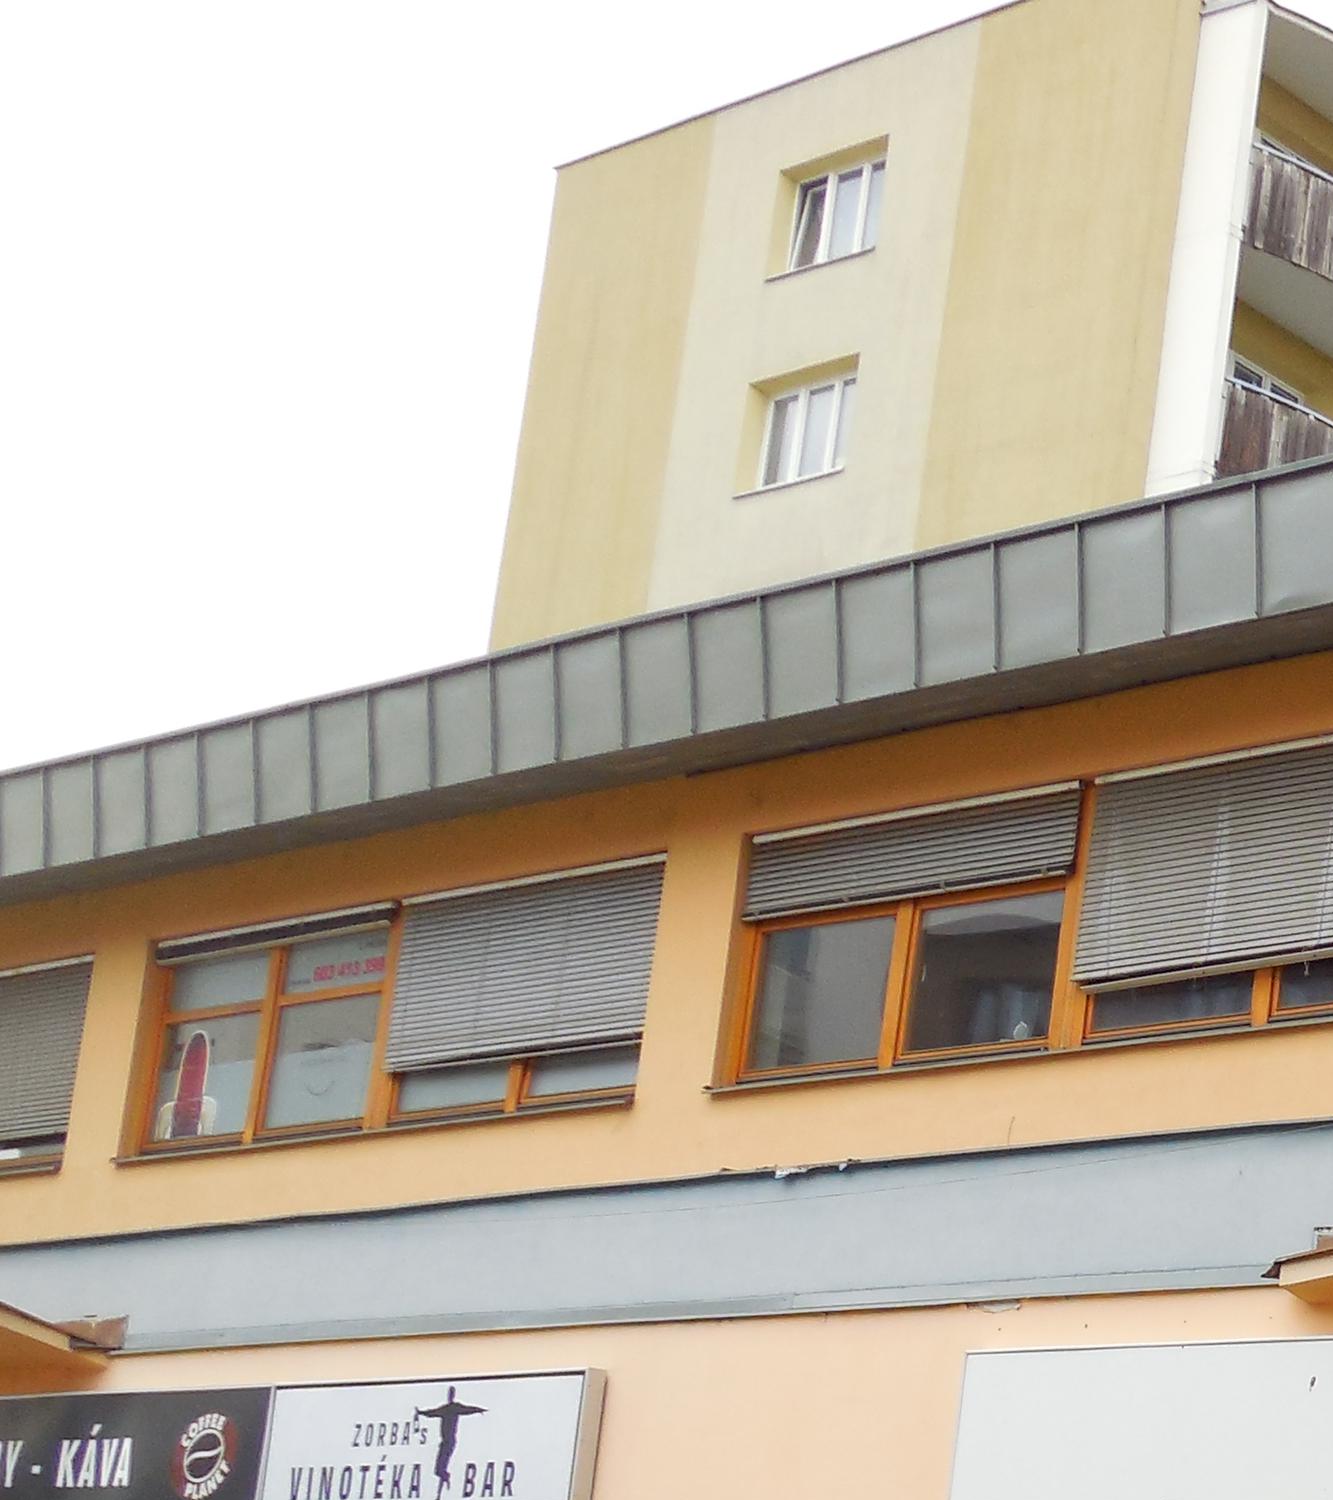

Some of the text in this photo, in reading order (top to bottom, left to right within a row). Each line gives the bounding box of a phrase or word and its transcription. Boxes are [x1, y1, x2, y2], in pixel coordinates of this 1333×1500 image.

[180, 1413, 227, 1448] COFFEE
[55, 1423, 133, 1488] KÁVA
[290, 1455, 515, 1500] VINOTÉKA BAR
